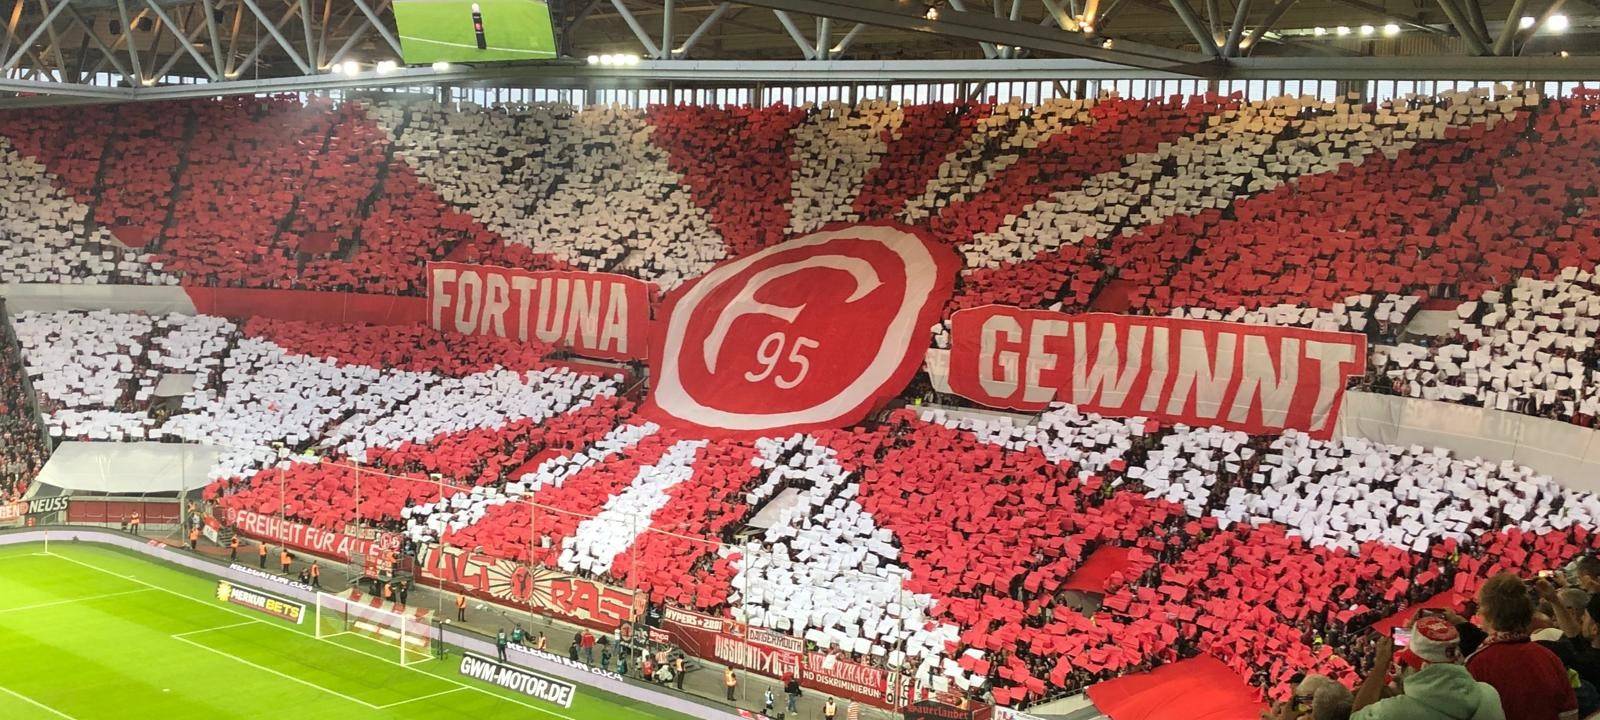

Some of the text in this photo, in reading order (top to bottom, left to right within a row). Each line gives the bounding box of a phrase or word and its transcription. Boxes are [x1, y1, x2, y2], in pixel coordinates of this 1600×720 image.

[433, 268, 628, 355] FORTUNA
[744, 331, 820, 390] 95
[978, 314, 1357, 432] GEWINNT
[29, 496, 69, 514] NEUSS
[236, 510, 304, 545] FREIHEIT
[305, 525, 335, 551] FÜR
[231, 588, 300, 618] MERKUR BETS
[665, 607, 697, 626] HYPERS
[460, 656, 570, 705] GWM-MOTOR.DE
[816, 673, 882, 699] DISKRIMINIERUN
